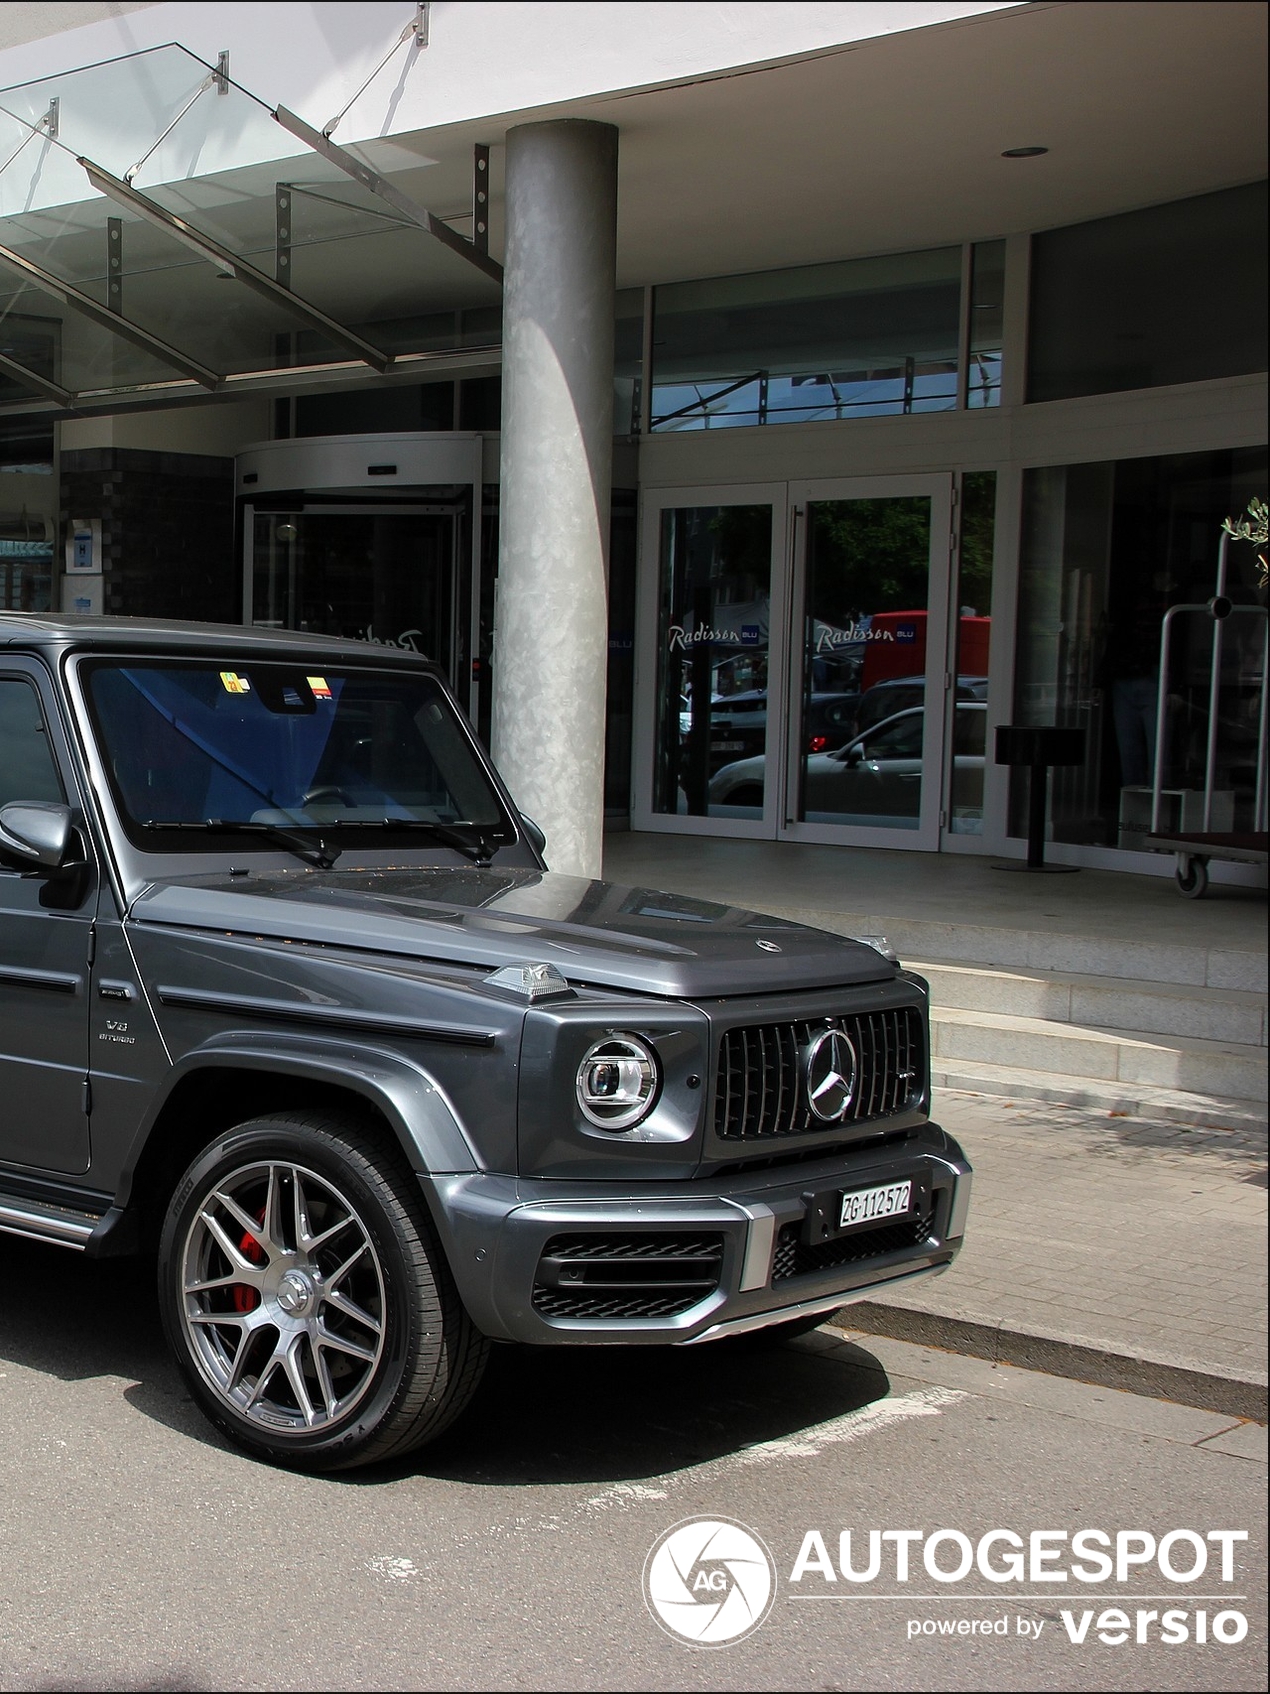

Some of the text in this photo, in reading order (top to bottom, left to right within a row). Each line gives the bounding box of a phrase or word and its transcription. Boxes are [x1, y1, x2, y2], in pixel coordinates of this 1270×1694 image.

[669, 622, 740, 652] Radisson
[816, 620, 895, 652] Radisson
[106, 1020, 128, 1032] V8
[99, 1033, 136, 1045] BITURBO
